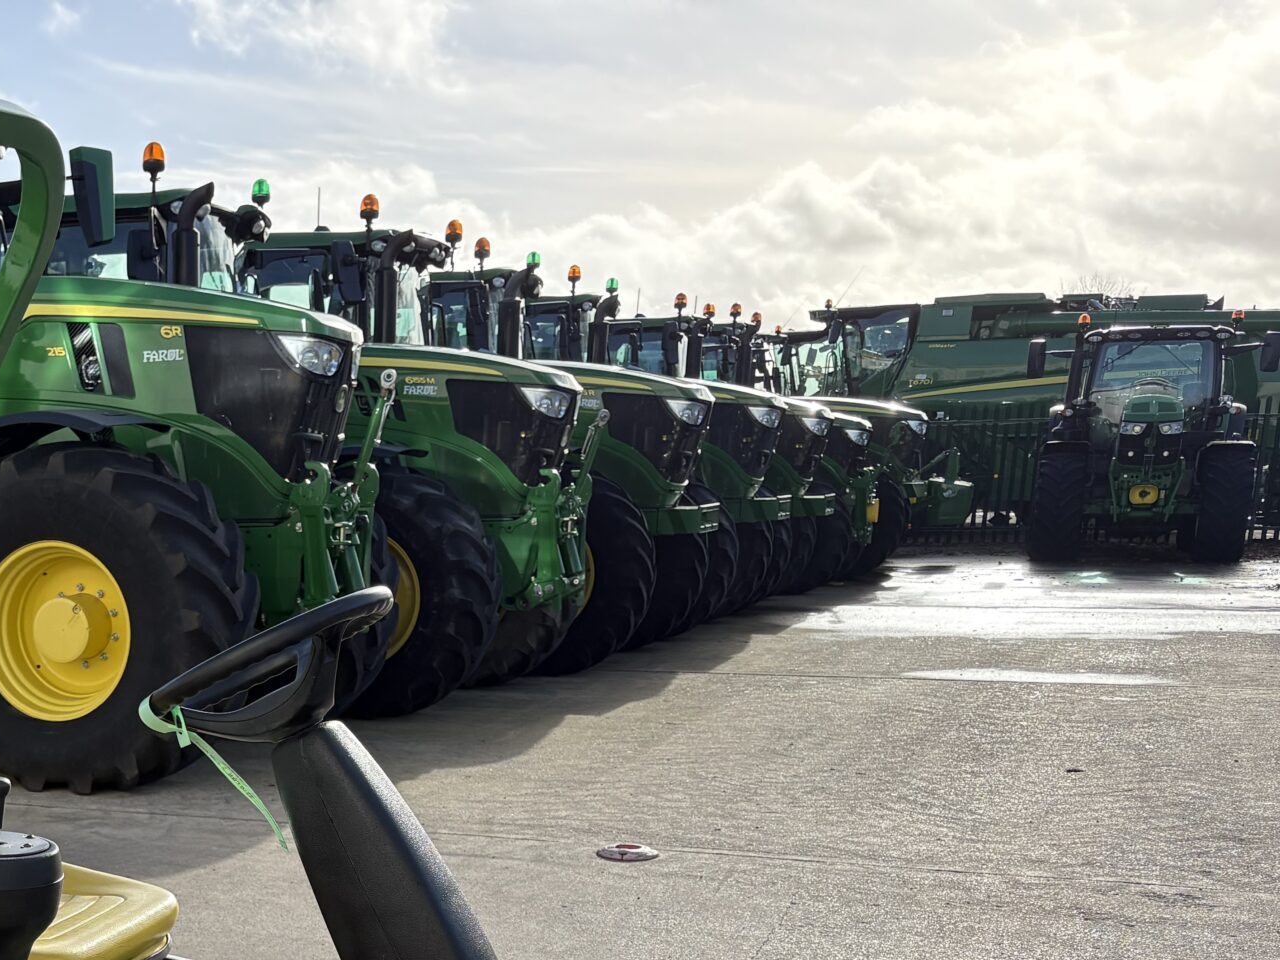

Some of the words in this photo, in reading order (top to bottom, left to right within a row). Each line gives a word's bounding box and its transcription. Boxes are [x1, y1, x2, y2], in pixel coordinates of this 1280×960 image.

[160, 325, 182, 338] 6R
[46, 347, 66, 357] 215
[143, 349, 183, 363] FAROL
[403, 385, 437, 395] FAROL
